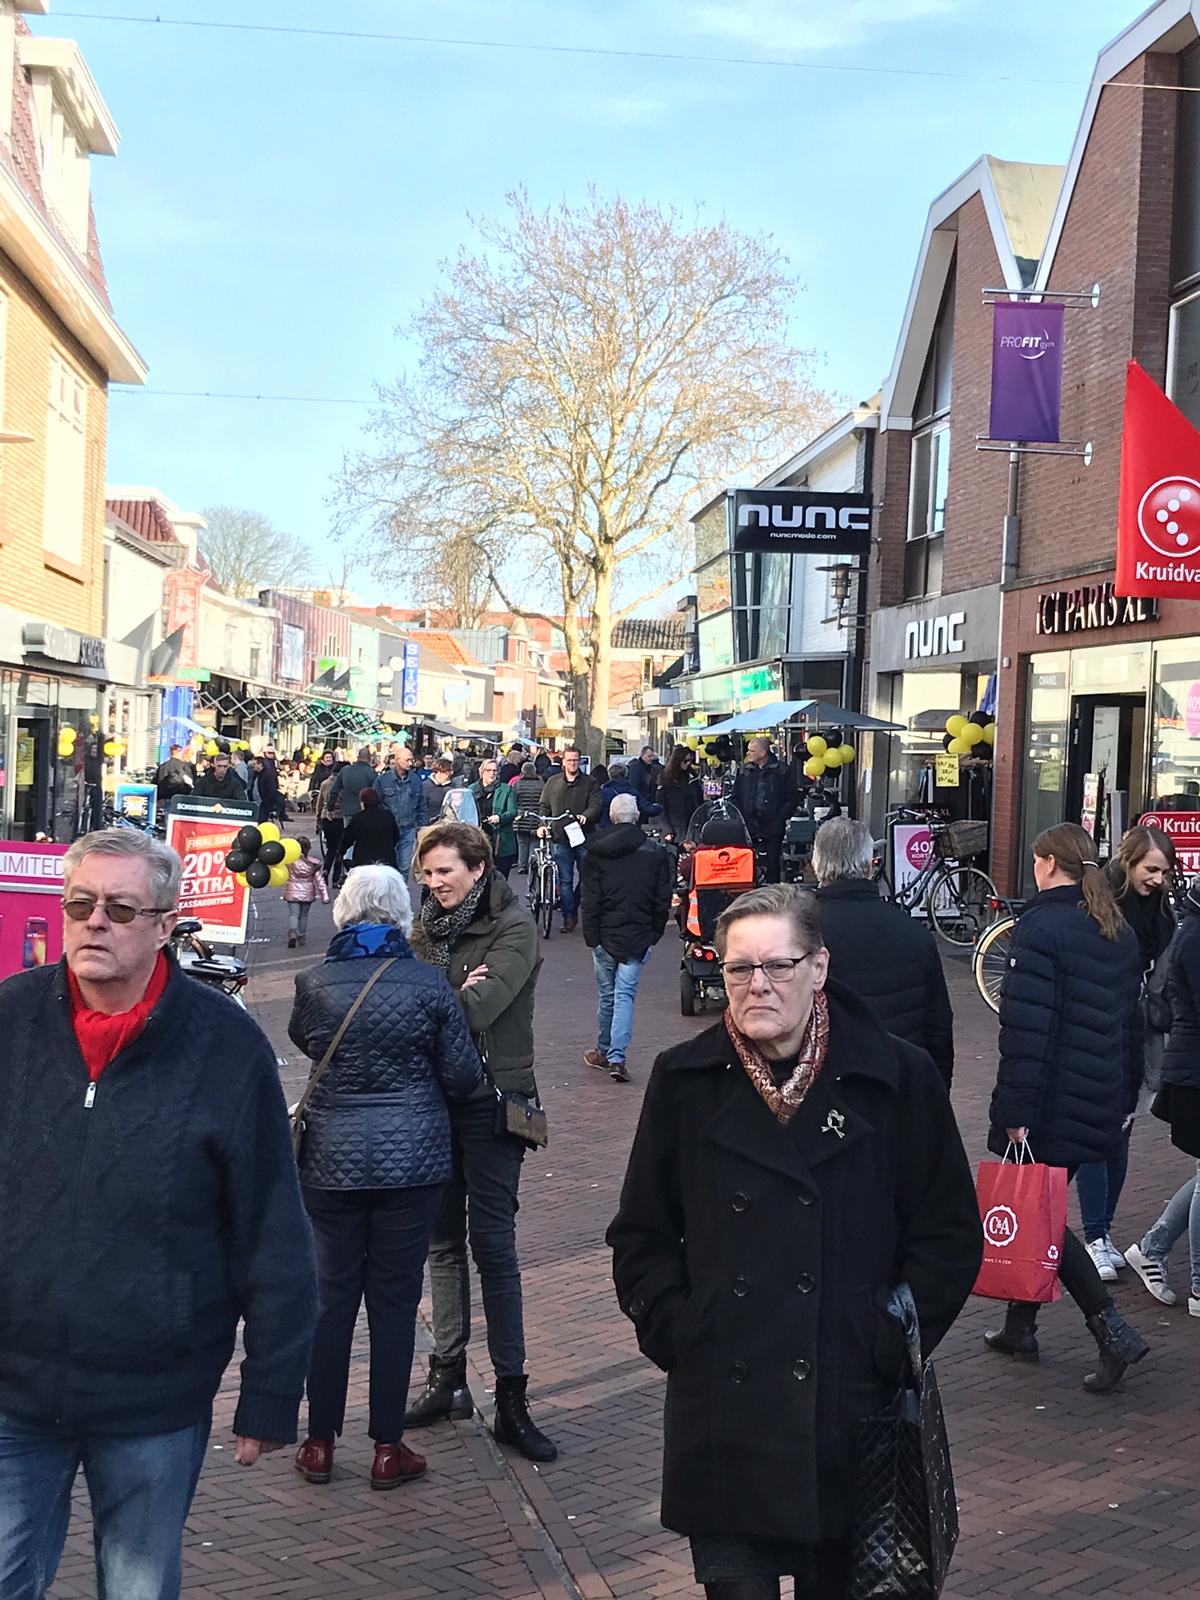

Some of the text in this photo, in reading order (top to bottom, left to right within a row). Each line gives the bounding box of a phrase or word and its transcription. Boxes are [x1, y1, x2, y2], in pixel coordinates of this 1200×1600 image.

[738, 504, 869, 530] nunc
[904, 611, 965, 659] nunc
[404, 643, 420, 706] SEIKO
[180, 875, 235, 896] EXTRA
[989, 1216, 1011, 1235] C&A
